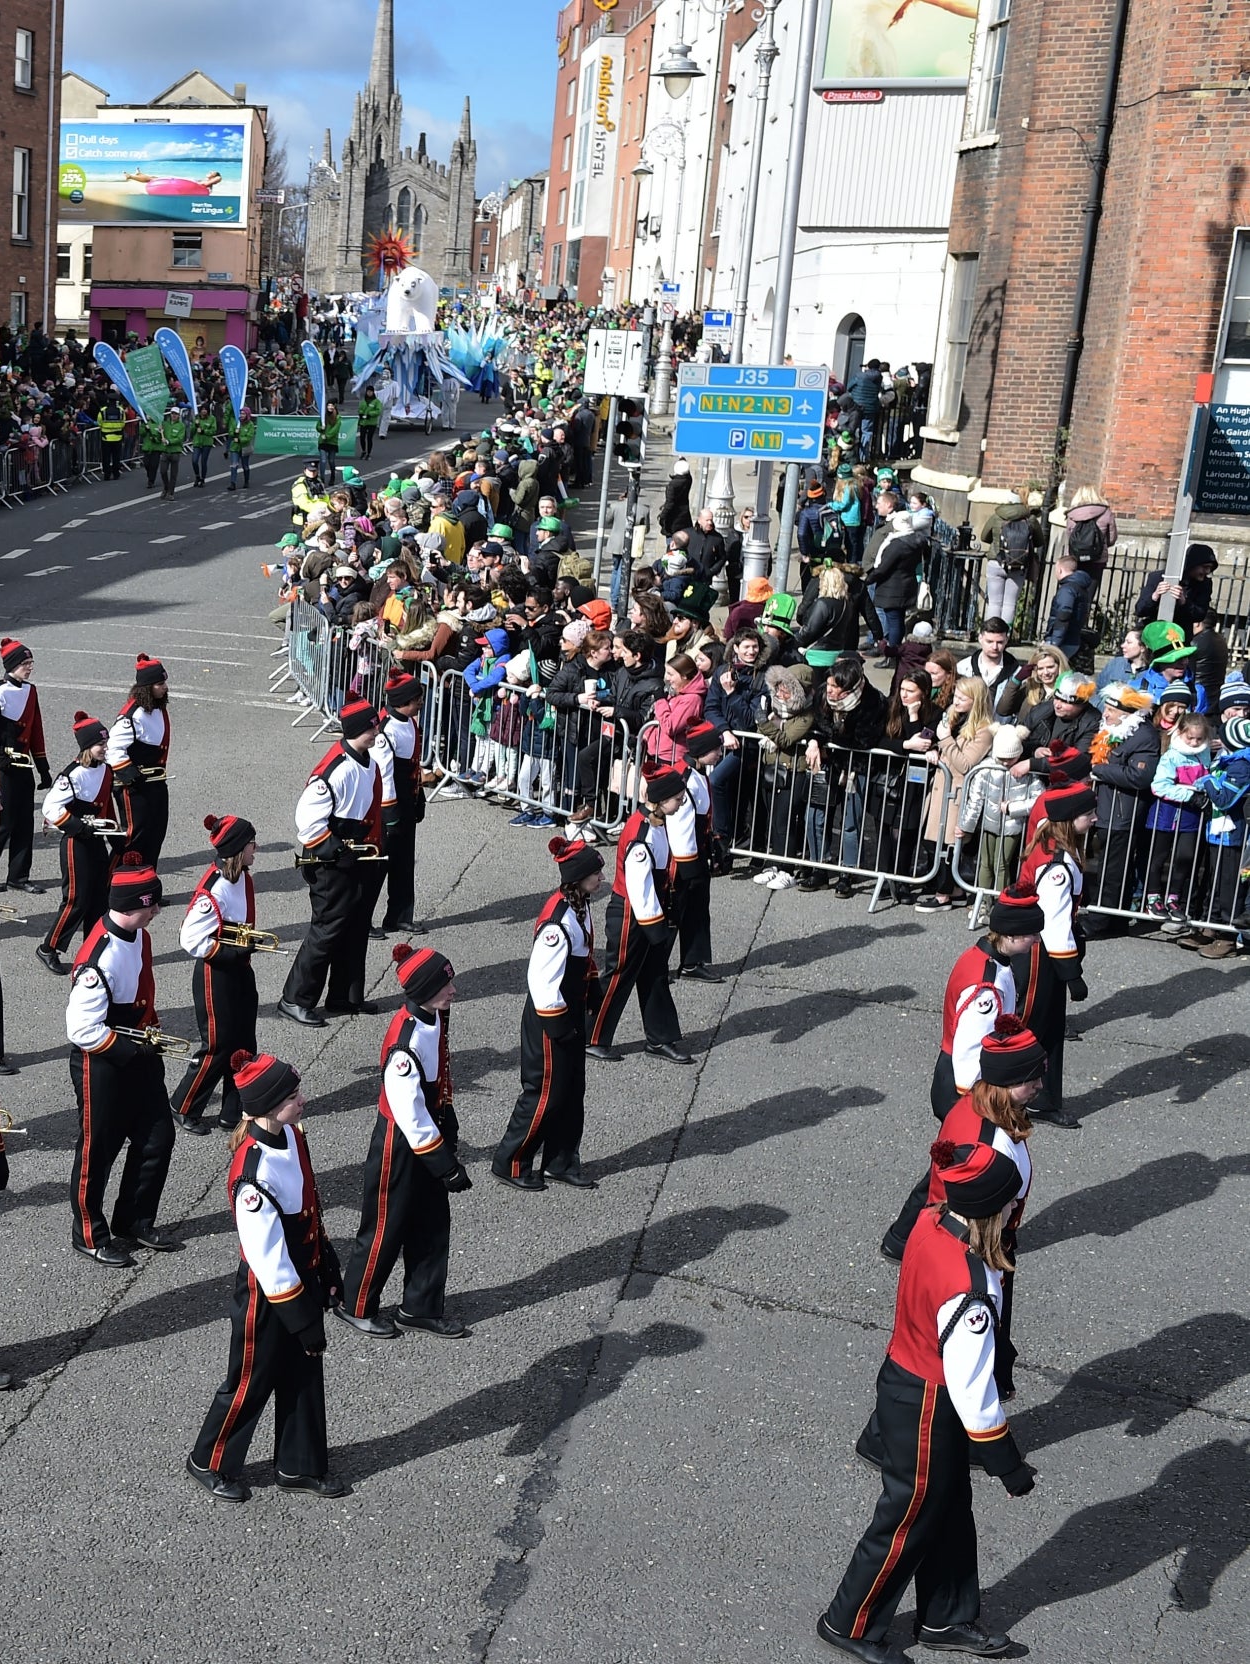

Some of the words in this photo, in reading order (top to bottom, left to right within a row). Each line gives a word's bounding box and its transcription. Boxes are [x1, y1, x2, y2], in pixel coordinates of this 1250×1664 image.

[851, 91, 877, 99] Media
[79, 135, 97, 144] Dull
[98, 135, 119, 146] days
[78, 148, 103, 158] Catch
[104, 150, 128, 158] some
[129, 151, 148, 160] rays
[593, 130, 607, 179] HOTEL
[61, 173, 83, 183] 25%
[202, 207, 224, 216] Lingus
[735, 369, 769, 385] J35
[1215, 406, 1229, 414] An
[1215, 415, 1230, 423] The
[1211, 437, 1241, 445] Garden
[1208, 458, 1236, 466] Writers
[1220, 480, 1244, 488] James
[1201, 500, 1229, 509] Temple
